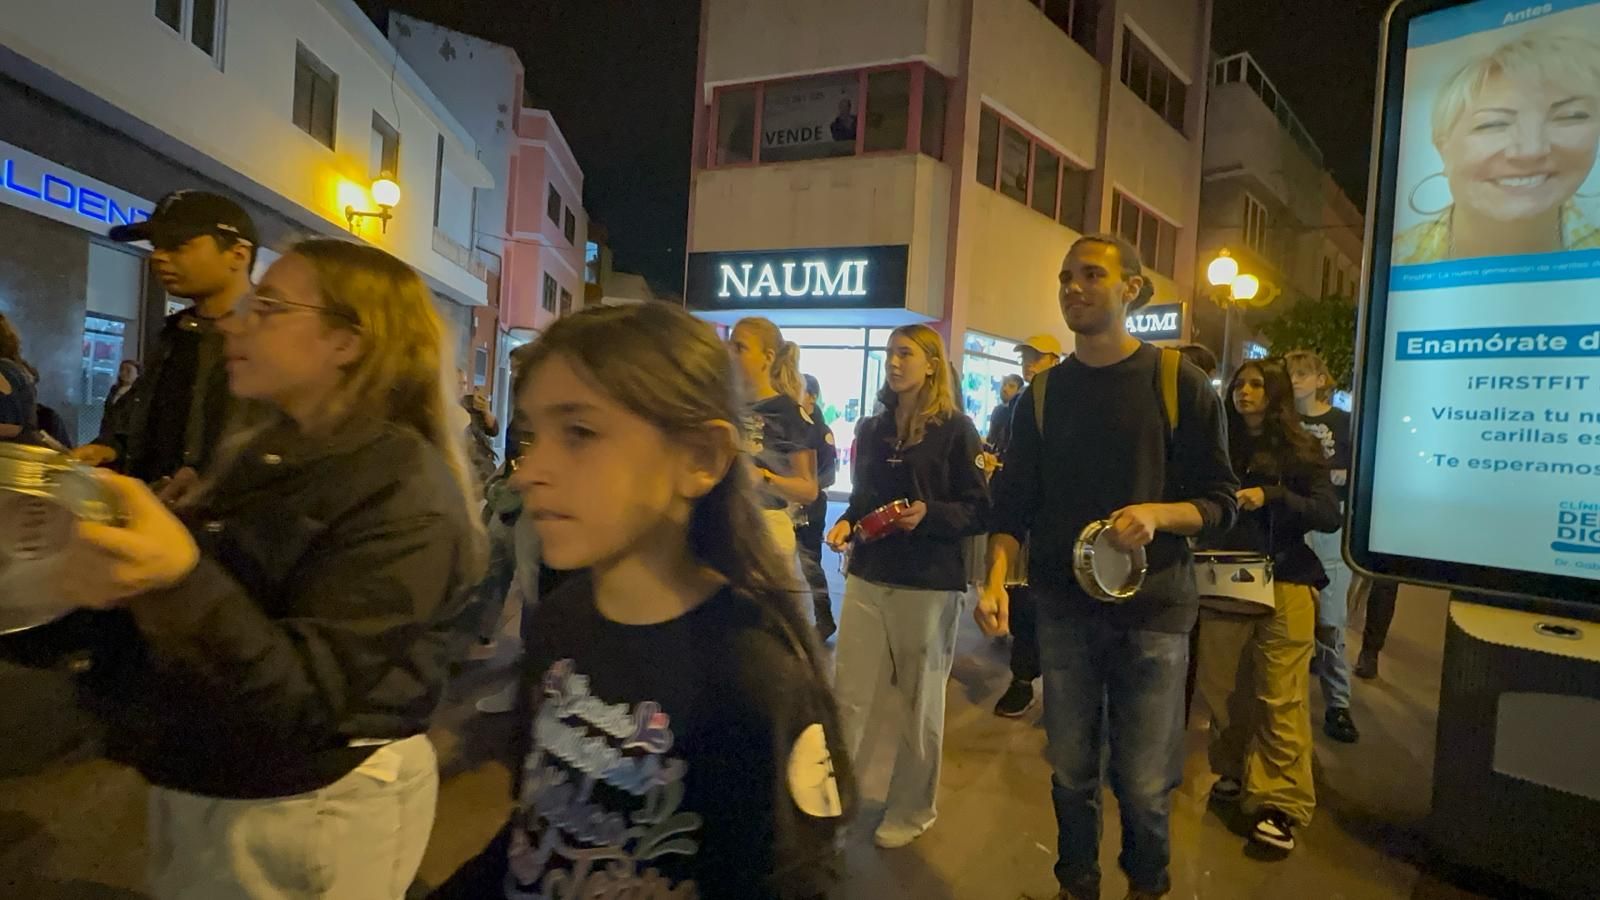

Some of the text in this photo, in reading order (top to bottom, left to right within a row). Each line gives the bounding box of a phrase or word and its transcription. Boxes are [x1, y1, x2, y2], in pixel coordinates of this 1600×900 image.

[1503, 3, 1552, 25] Antes
[765, 126, 823, 146] VENDE
[0, 159, 151, 225] LDEN
[718, 260, 868, 297] NAUMI
[1125, 312, 1178, 333] AUMI
[1407, 332, 1567, 354] Enamórate
[1467, 375, 1590, 390] ¡FIRSTFIT
[1431, 407, 1535, 421] Visualiza
[1544, 409, 1569, 422] tu
[1481, 428, 1568, 444] carillas
[1433, 454, 1460, 467] Te
[1560, 501, 1600, 511] CLÍNI
